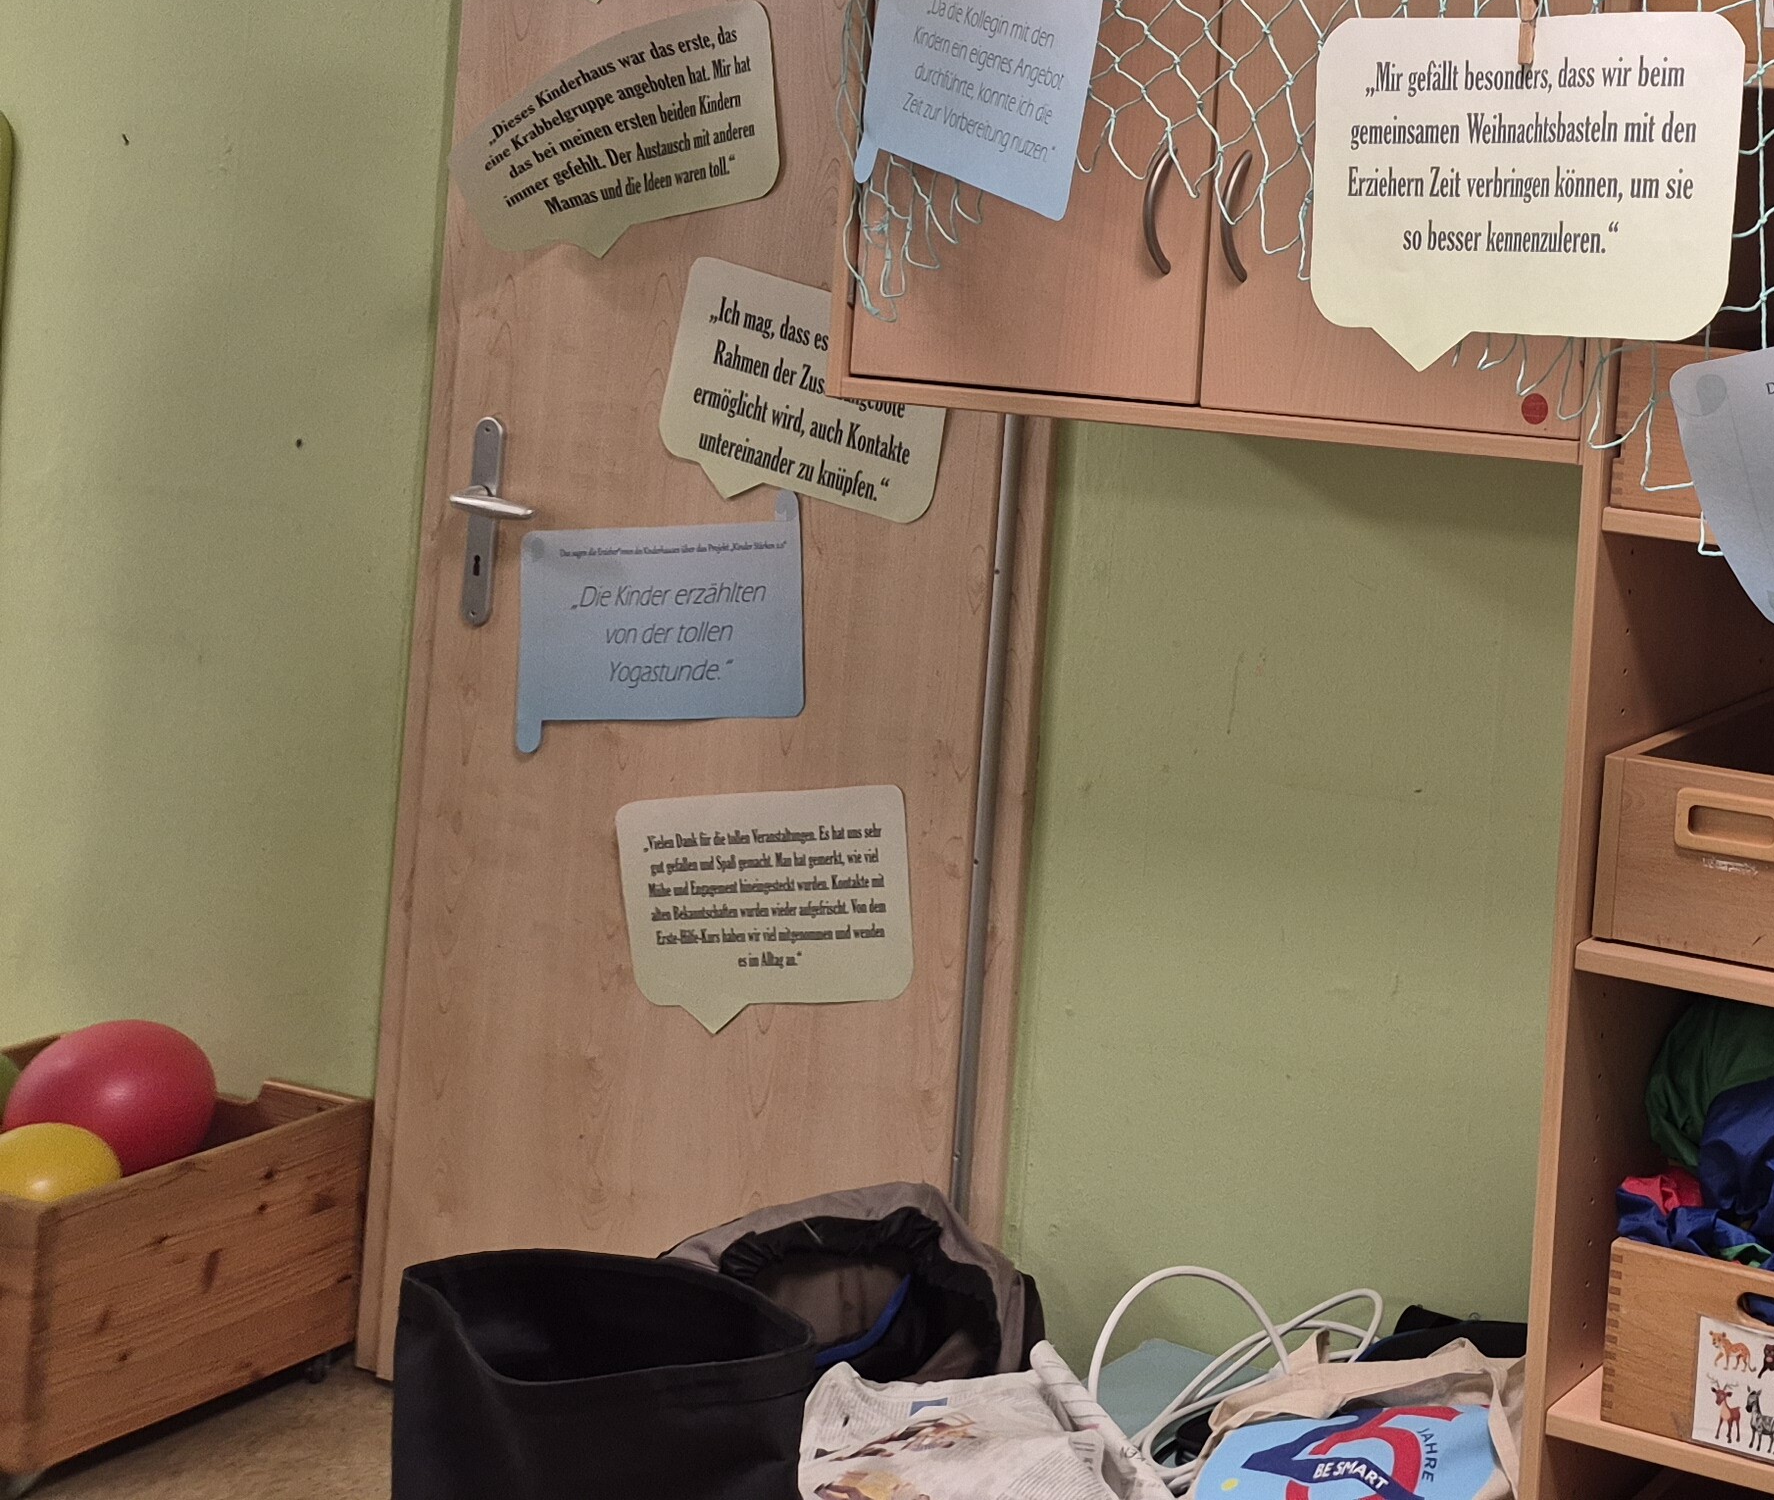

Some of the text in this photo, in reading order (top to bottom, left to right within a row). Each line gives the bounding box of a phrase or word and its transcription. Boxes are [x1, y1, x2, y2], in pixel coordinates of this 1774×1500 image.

[1366, 55, 1684, 97] „Mir gefällt besonders, dass wir beim
[509, 92, 741, 178] das bei meinen ersten beiden Kindern
[1351, 111, 1696, 150] gemeinsamen Weihnachtsbasteln mit den
[504, 122, 755, 207] immer gefehlt. Der Austausch mit anderen
[544, 155, 735, 214] Mamas und die Ideen waren toll.“
[1348, 166, 1693, 203] Erziehern Zeit verbringen können, um sie
[1403, 220, 1618, 253] so besser kennenzuleren.“
[710, 296, 829, 351] „Ich mag, dass es
[713, 339, 769, 378] Rahmen
[773, 358, 797, 385] der
[693, 388, 910, 465] ermöglicht wird, auch Kontakte
[699, 433, 889, 501] untereinander zu knüpfen.“
[571, 582, 766, 609] „Die Kinder erzählten
[606, 622, 733, 644] von der tollen
[610, 659, 733, 689] Yogastunde.“
[1313, 1460, 1389, 1489] BE SMART
[1418, 1428, 1438, 1482] JAHRE
